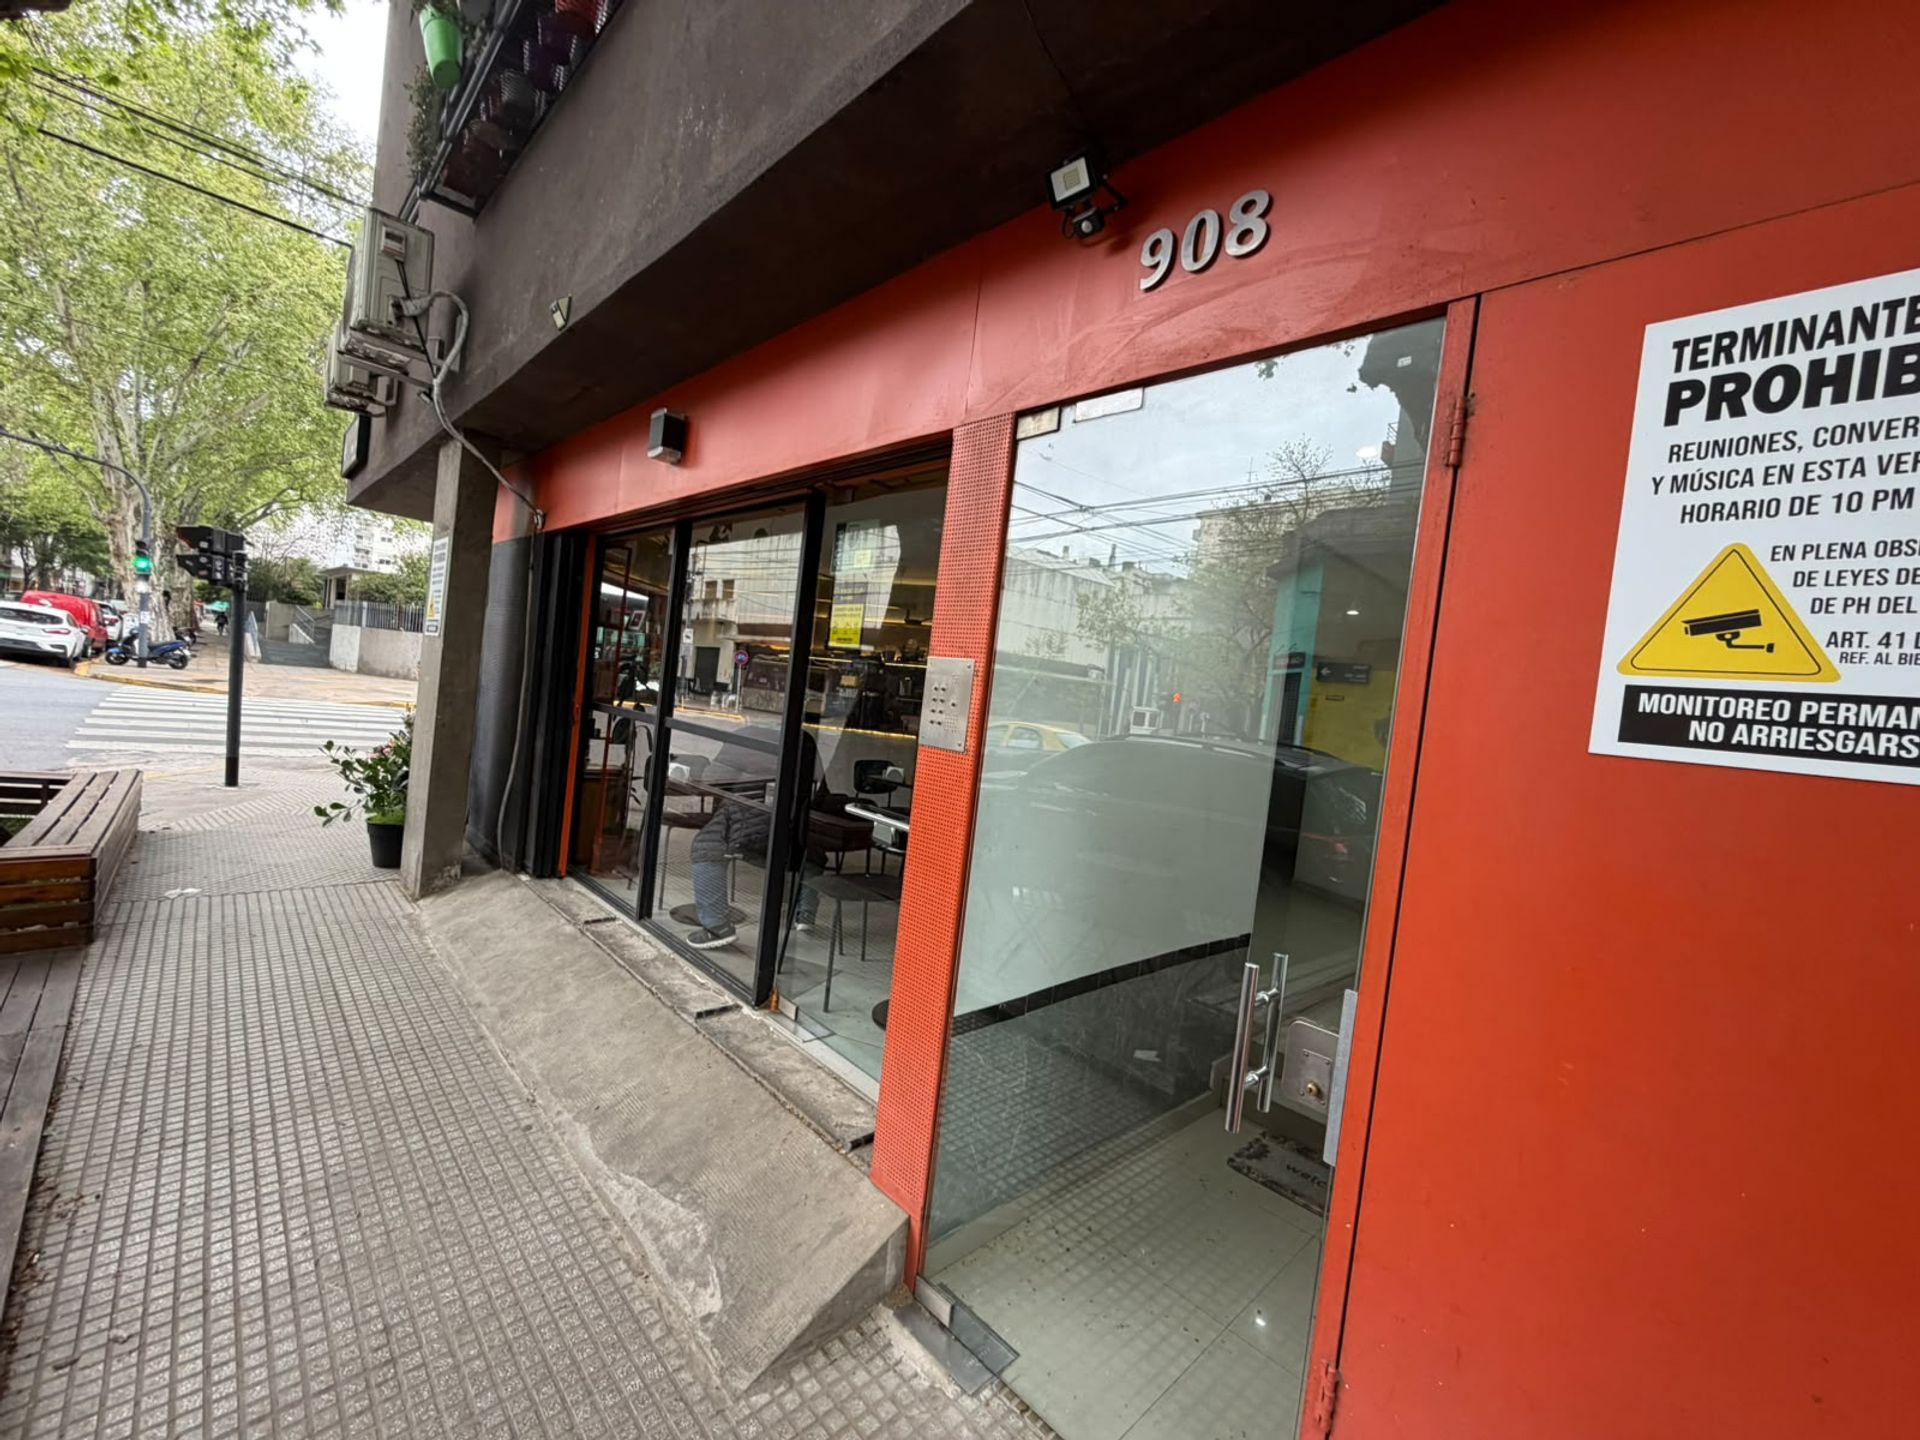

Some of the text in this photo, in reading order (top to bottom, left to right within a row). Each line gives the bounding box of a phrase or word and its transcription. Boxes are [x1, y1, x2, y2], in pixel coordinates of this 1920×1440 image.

[1139, 190, 1270, 290] 908
[1672, 294, 1920, 374] TERMINANTE
[1663, 342, 1920, 427] PROHIB
[1668, 415, 1920, 464] REUNIONES, CONVER
[1652, 475, 1665, 495] Y
[1669, 467, 1754, 494] MÚSICA
[1762, 464, 1795, 486] EN
[1802, 456, 1866, 483] ESTA
[1680, 486, 1916, 524] HORARIO DE 10 PM
[1770, 538, 1920, 562] EN PLENA OBS
[1793, 567, 1920, 587] DE LEYES DE
[1810, 596, 1918, 614] DE PH DEL
[1825, 631, 1870, 649] ART.
[1877, 631, 1906, 649] 41
[1839, 651, 1869, 665] REF.
[1873, 652, 1893, 665] AL
[1638, 692, 1791, 723] MONITOREO
[1688, 720, 1920, 759] NO ARRIESGARS
